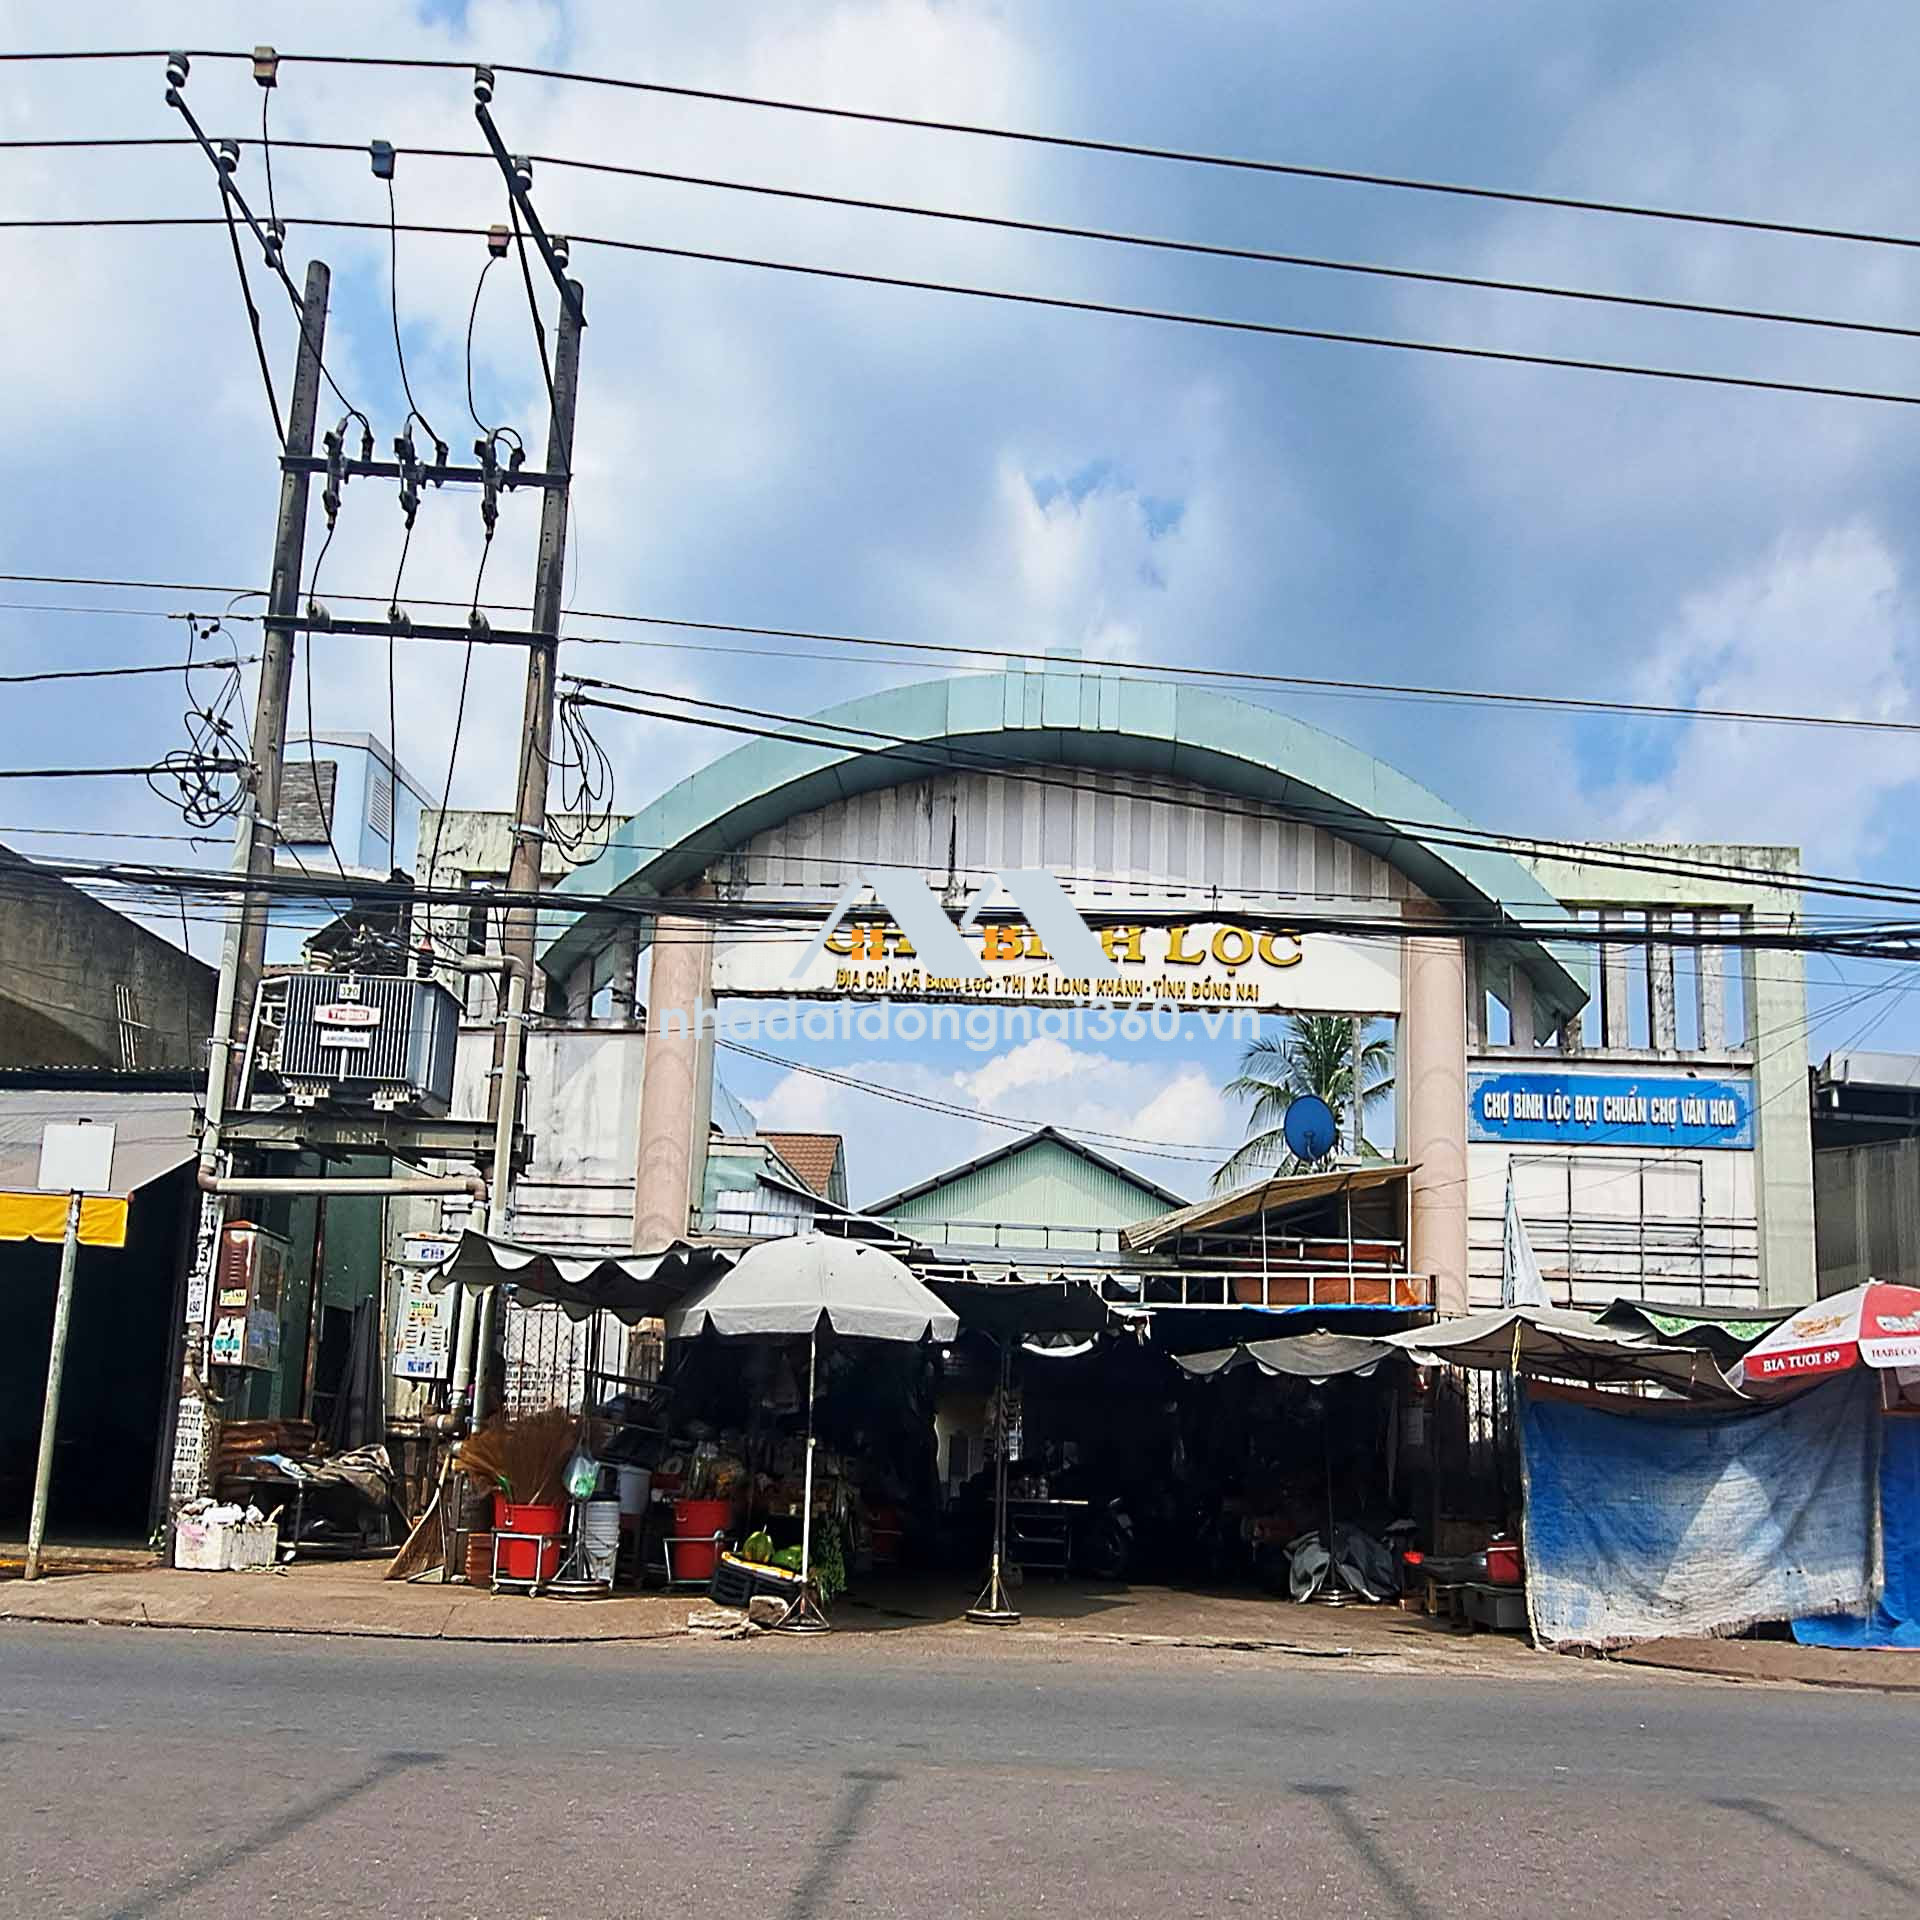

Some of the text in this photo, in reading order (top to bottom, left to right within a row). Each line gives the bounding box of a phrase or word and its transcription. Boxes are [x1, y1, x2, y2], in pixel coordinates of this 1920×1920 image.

[1054, 977, 1091, 997] LONG
[1236, 984, 1260, 1003] NAI
[1484, 1090, 1510, 1125] CHỢ
[1513, 1087, 1544, 1120] BÌNH
[1547, 1087, 1571, 1126] LỘC
[1651, 1097, 1677, 1130] CHỢ
[1682, 1092, 1706, 1125] VĂN
[1763, 1357, 1785, 1373] BIA
[1824, 1350, 1841, 1364] 89
